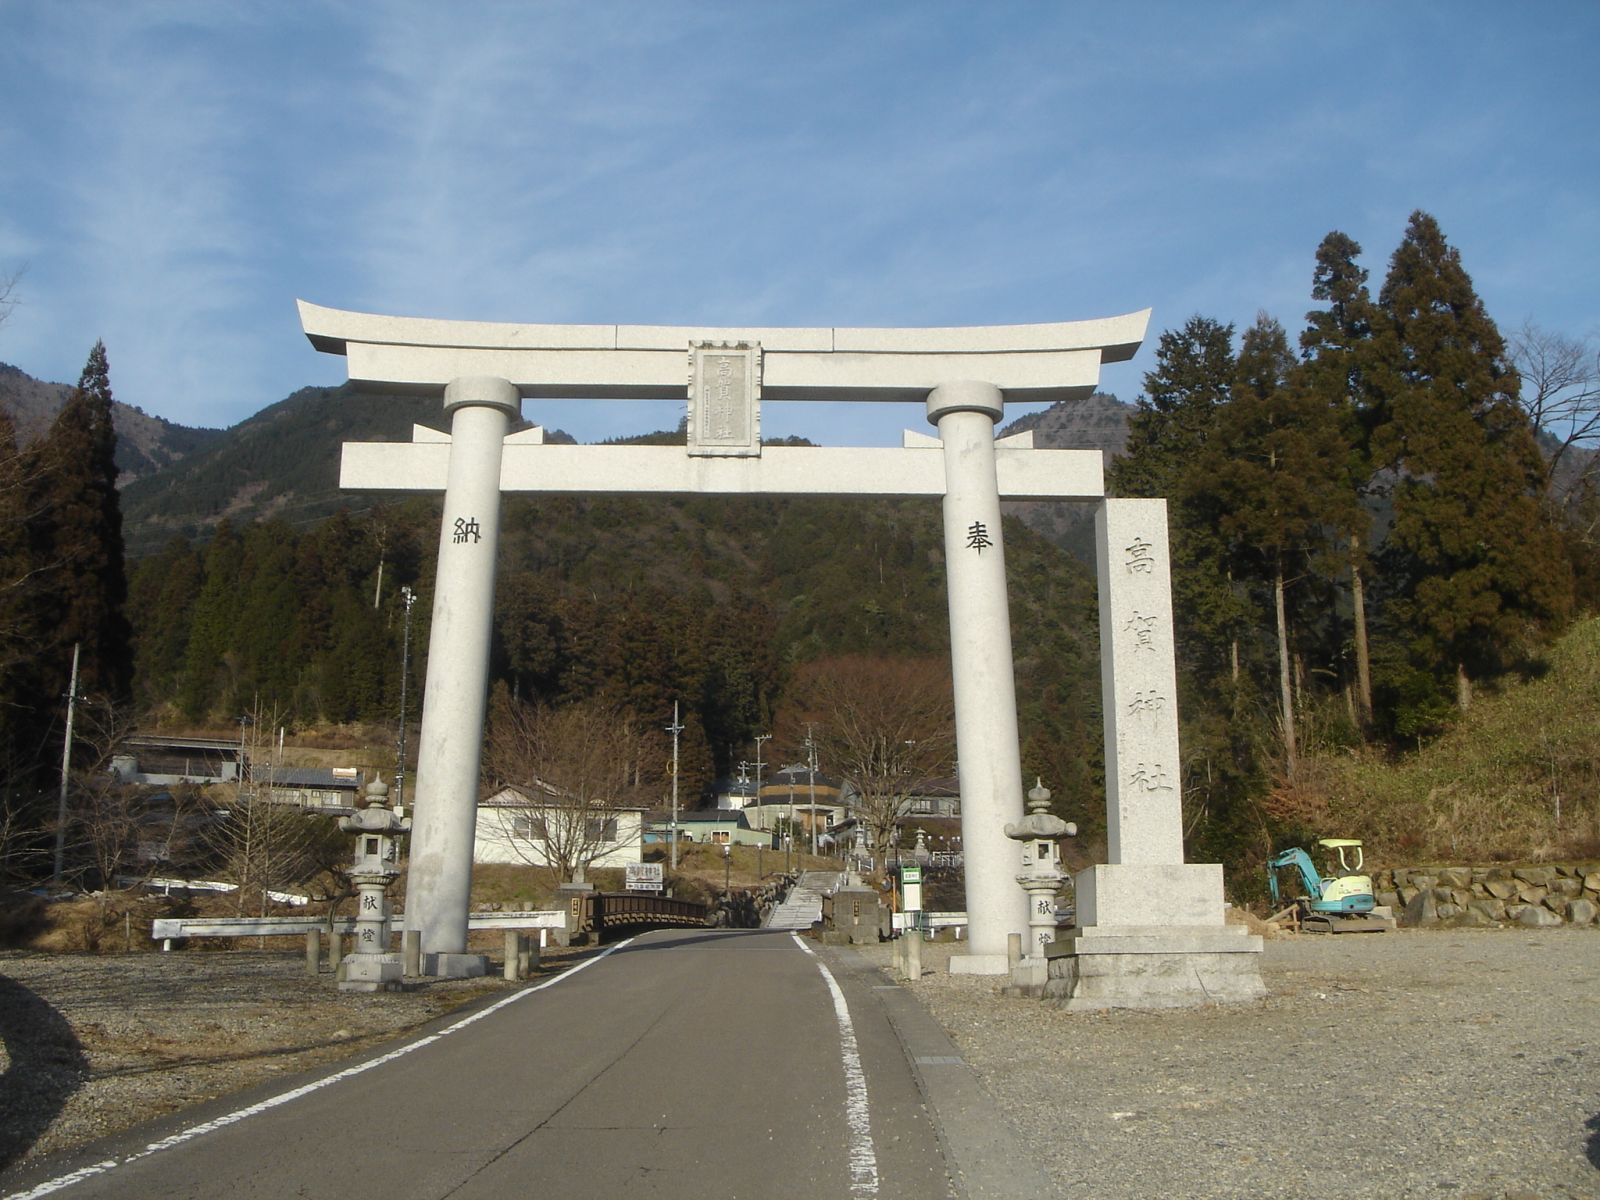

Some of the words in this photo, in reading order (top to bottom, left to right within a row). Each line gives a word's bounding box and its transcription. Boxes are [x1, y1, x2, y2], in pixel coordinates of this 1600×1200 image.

[452, 516, 482, 544] 納
[965, 521, 994, 556] 奉
[1123, 536, 1174, 794] 高賀神社
